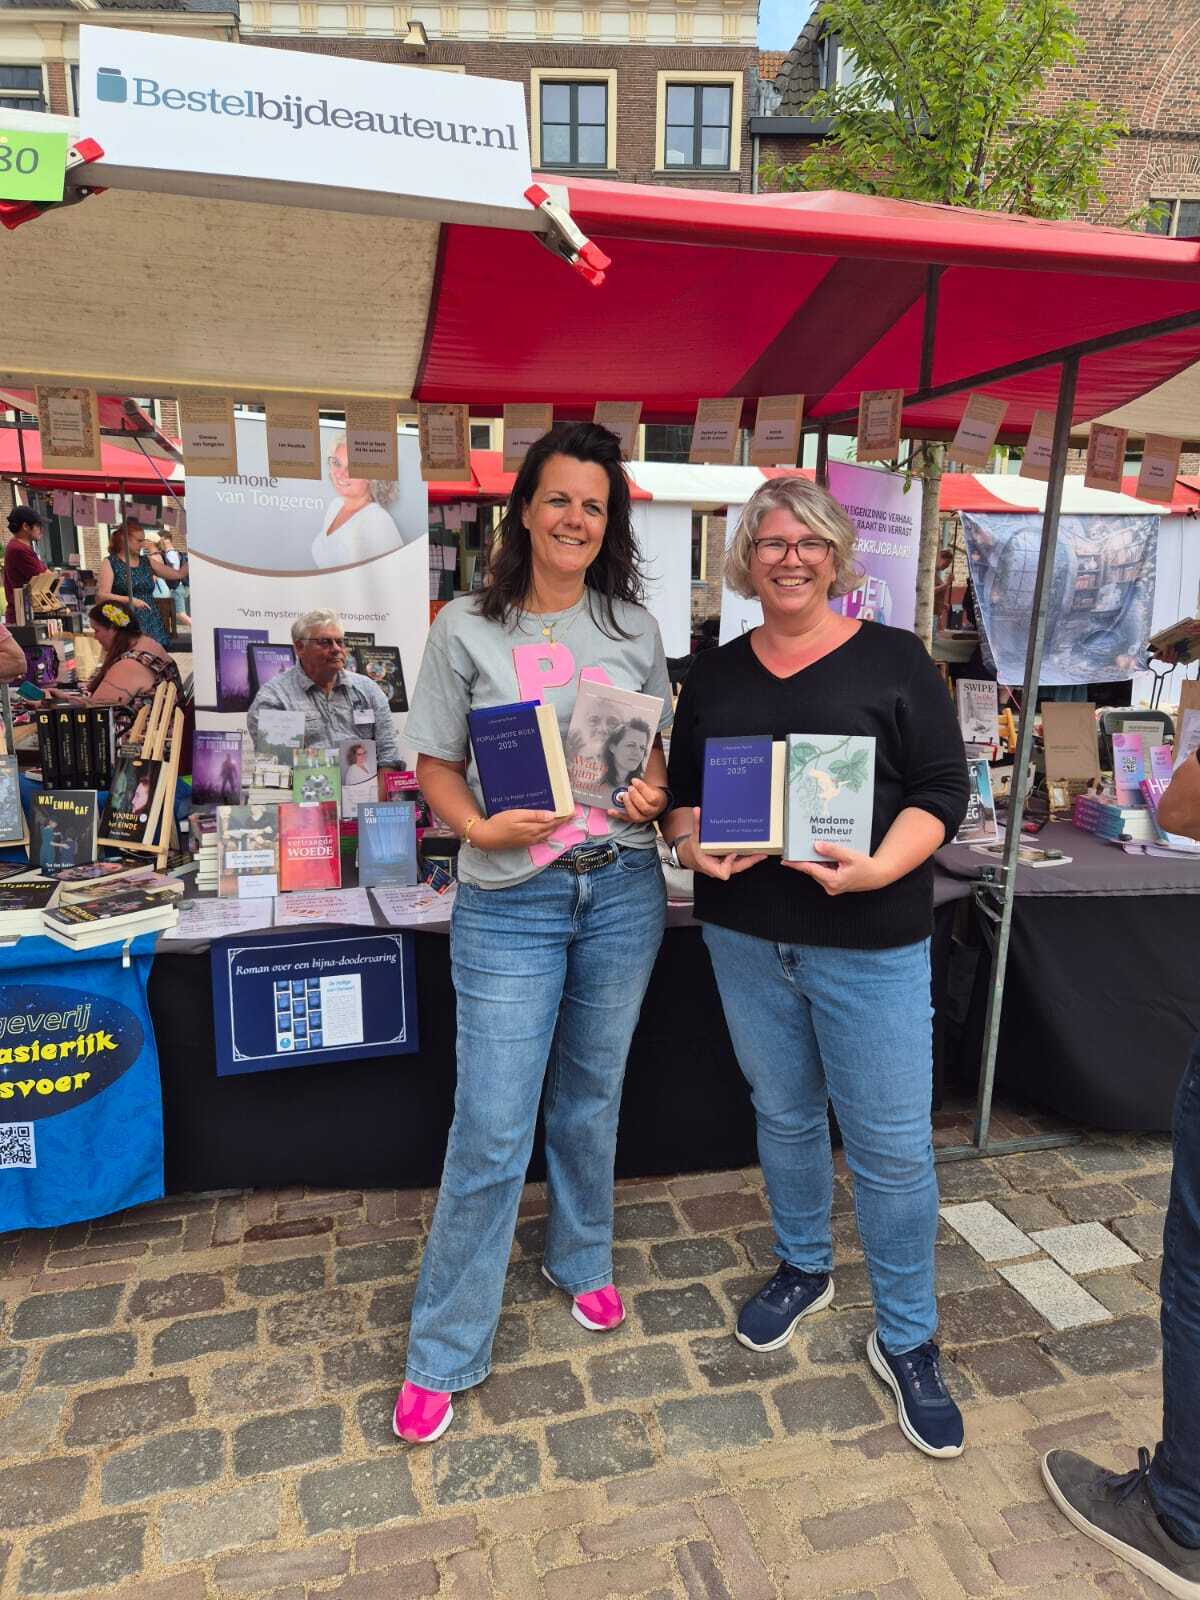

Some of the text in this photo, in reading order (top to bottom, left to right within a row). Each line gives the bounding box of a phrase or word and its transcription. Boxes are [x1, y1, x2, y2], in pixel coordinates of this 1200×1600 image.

[133, 77, 520, 152] Bestelbijdeauteur.nl
[217, 473, 279, 488] Simone
[216, 489, 324, 511] van Tongeren
[850, 506, 887, 520] EIGENZINNIG
[856, 520, 912, 536] RAAKT EN VERRAST
[340, 612, 390, 622] trospectie"
[964, 683, 994, 693] SWIPE
[498, 740, 518, 750] 2025
[710, 756, 764, 766] BESTE BOEK
[1148, 778, 1172, 795] HE
[38, 795, 89, 816] WAT EMMA GAF
[364, 807, 374, 817] DE
[809, 815, 855, 825] Madame
[811, 825, 852, 835] Bonheur
[287, 846, 334, 857] WOEDE
[235, 953, 397, 976] Roman over een bijna-doodervaring
